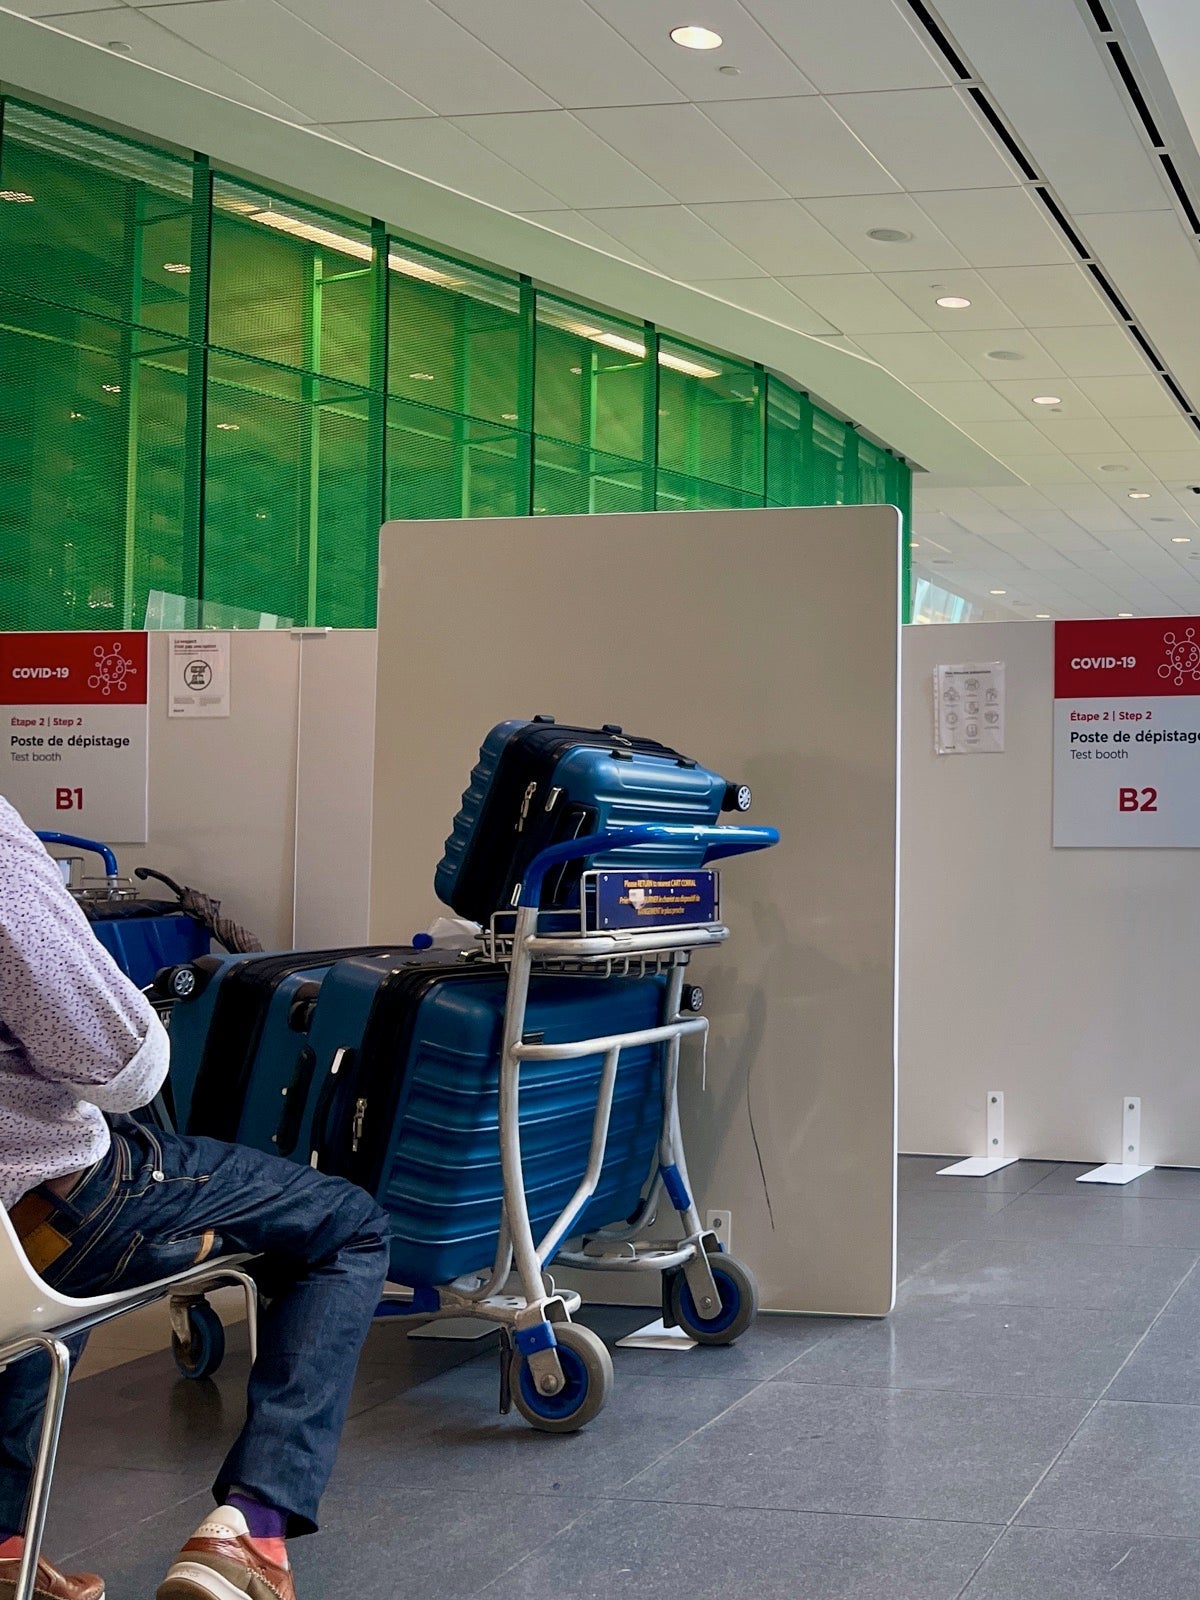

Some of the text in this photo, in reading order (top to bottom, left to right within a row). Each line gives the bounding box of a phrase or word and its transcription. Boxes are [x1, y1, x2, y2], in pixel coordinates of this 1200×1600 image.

[1070, 656, 1137, 670] COVID-19
[12, 667, 70, 679] COVID-19
[1070, 710, 1099, 722] Étape
[1103, 711, 1109, 721] 2
[1119, 711, 1142, 722] Step
[1146, 710, 1152, 720] 2
[11, 717, 36, 728] Étape
[39, 717, 45, 727] 2
[53, 717, 74, 728] Step
[76, 717, 83, 727] 2
[10, 735, 130, 748] Poste de dépistage
[1070, 731, 1109, 743] Poste
[1113, 730, 1131, 743] de
[11, 752, 62, 762] Test booth
[1070, 748, 1129, 760] Test booth
[56, 787, 83, 810] B1
[1119, 787, 1158, 812] B2
